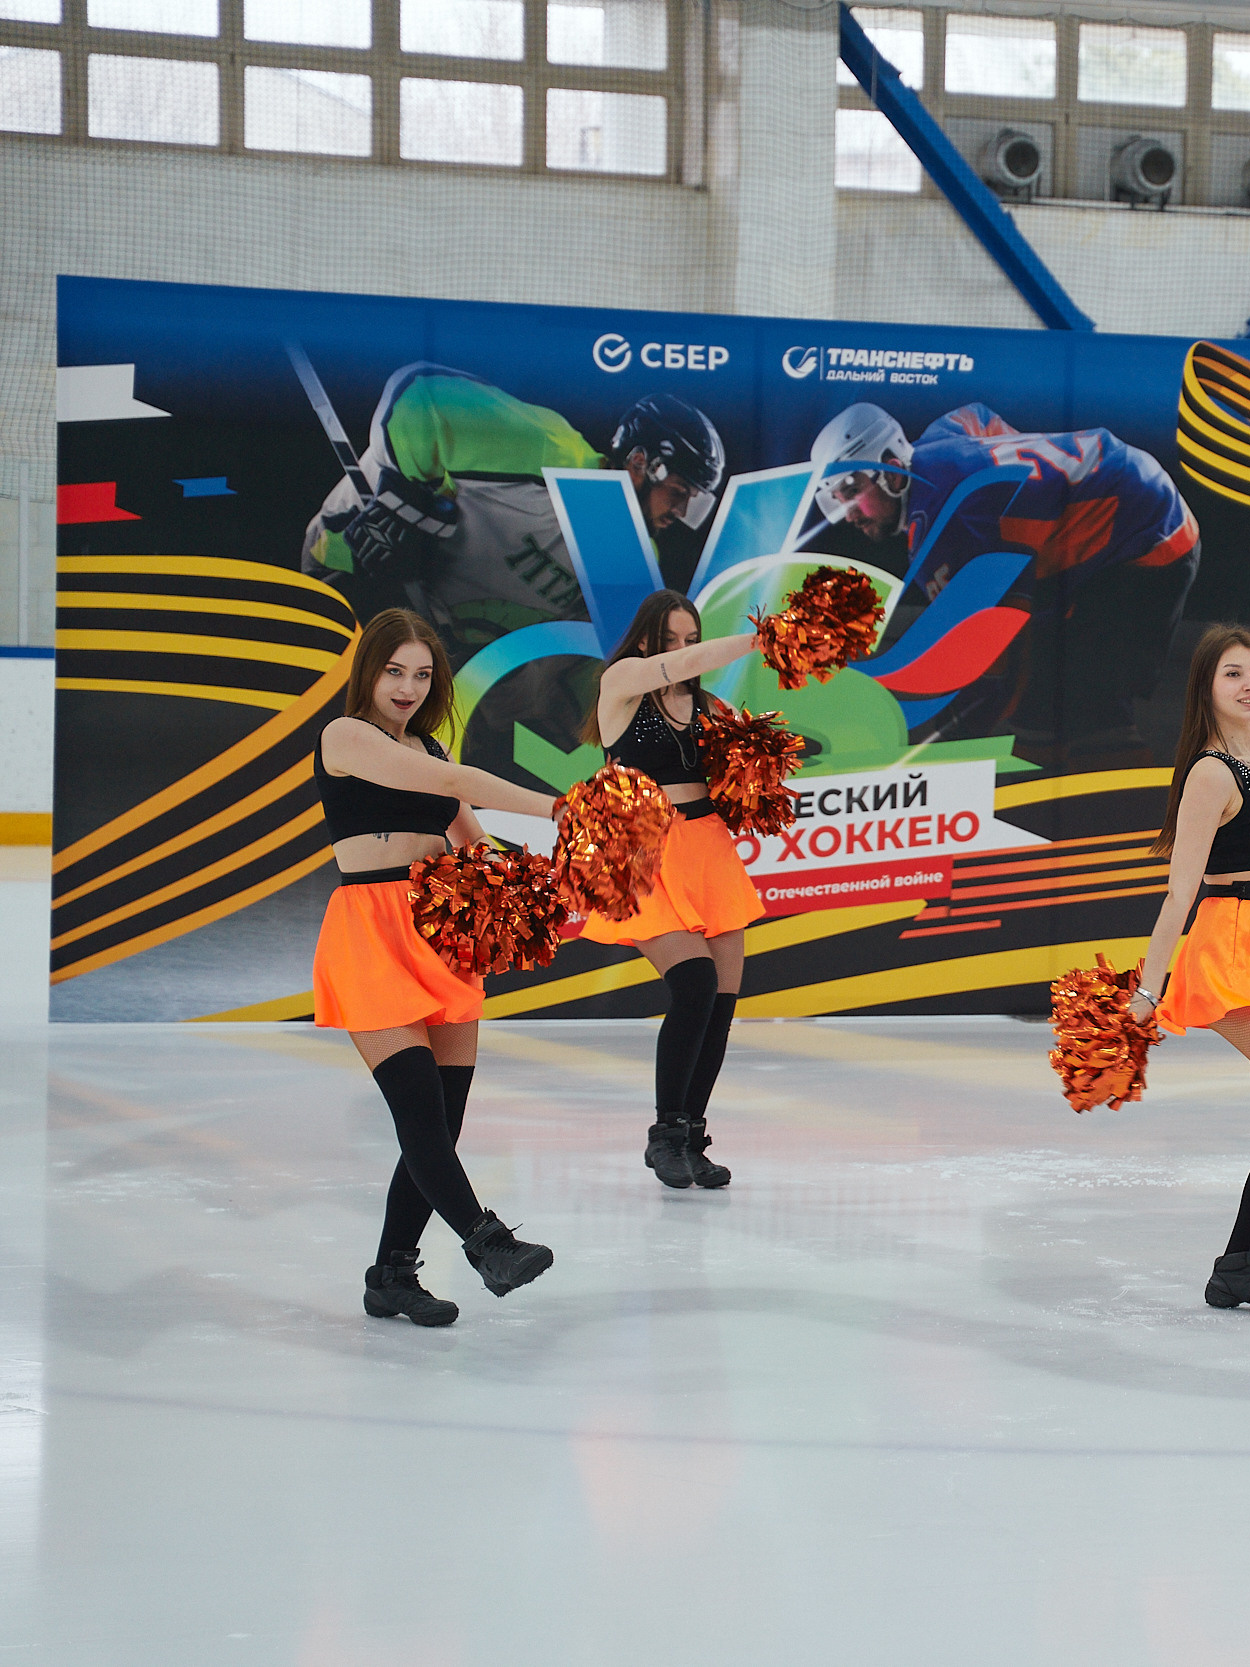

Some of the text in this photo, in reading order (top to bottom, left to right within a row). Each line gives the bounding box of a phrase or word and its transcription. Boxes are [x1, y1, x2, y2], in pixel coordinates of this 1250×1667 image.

[641, 343, 729, 370] СБЕР
[828, 347, 974, 372] ТРАНСНЕФТЬ
[826, 369, 939, 385] ДАЛЬНИЙ ВОСТОК
[795, 774, 927, 818] ЕСКИЙ
[734, 811, 979, 866] О ХОККЕЮ
[765, 874, 891, 901] Отечественной
[893, 870, 944, 888] войне
